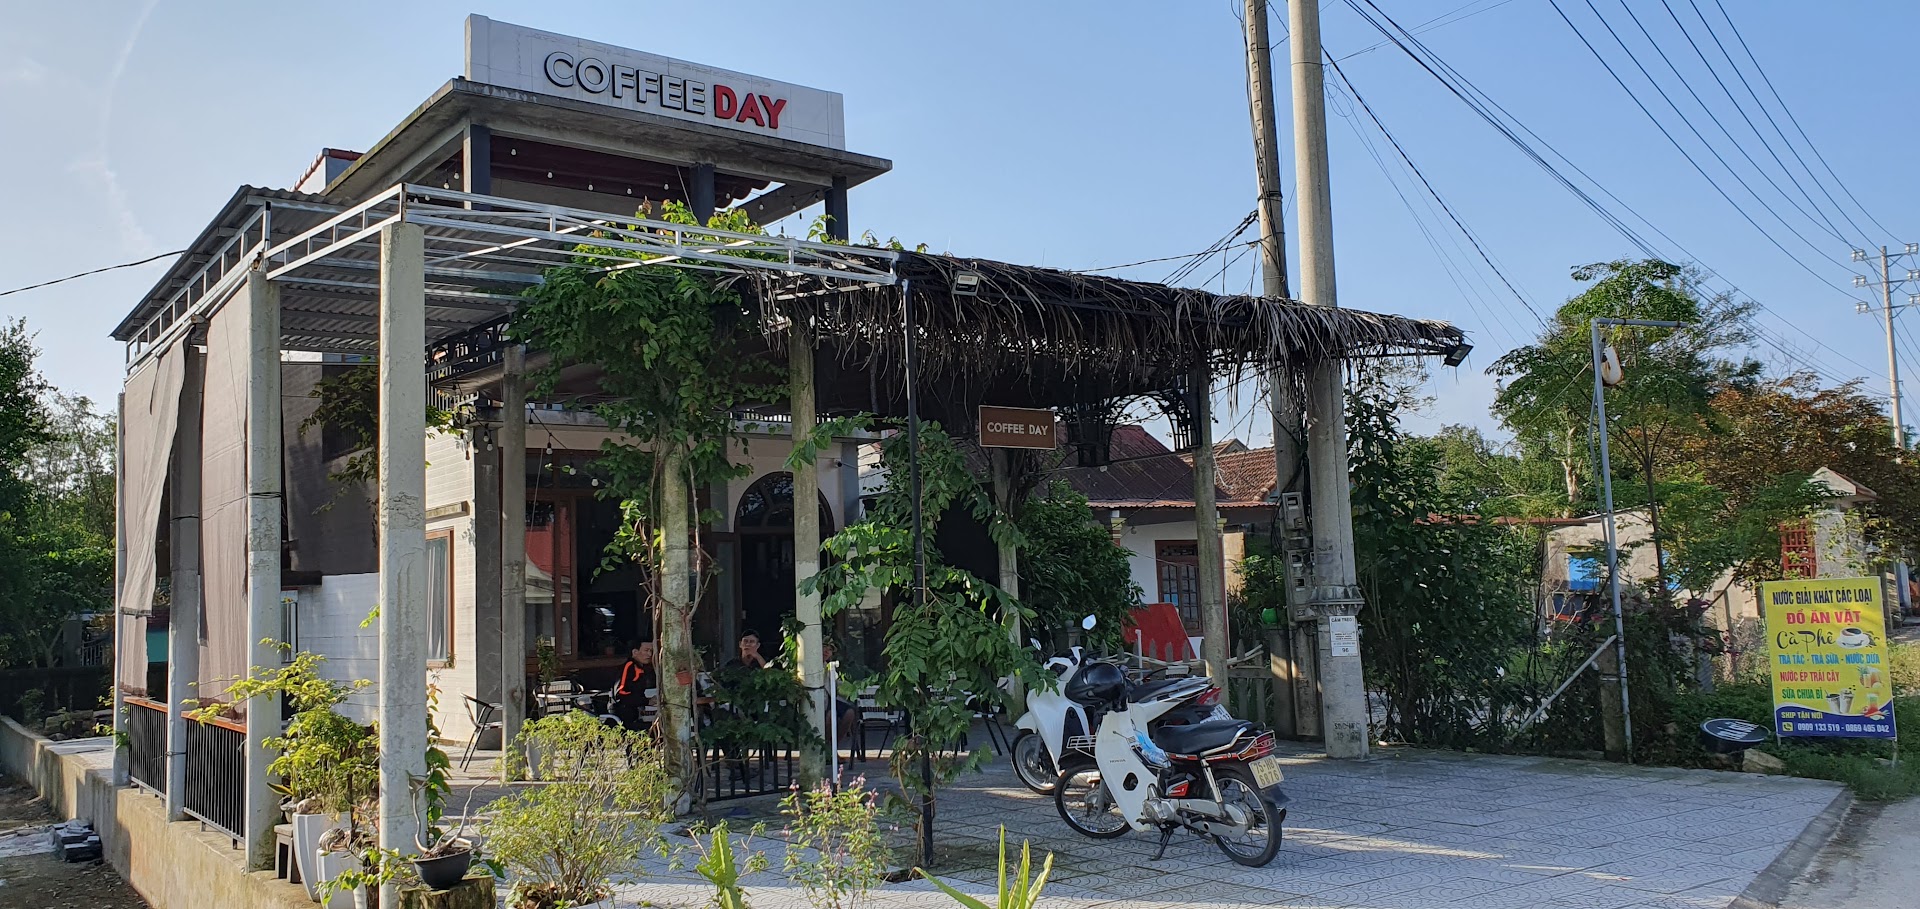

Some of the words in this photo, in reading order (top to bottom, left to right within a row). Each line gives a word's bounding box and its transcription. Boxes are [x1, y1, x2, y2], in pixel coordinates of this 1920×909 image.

[544, 51, 706, 115] COFFEE
[713, 84, 787, 130] DAY
[987, 422, 1025, 434] COFFEE
[1029, 424, 1048, 436] DAY
[1772, 588, 1794, 605] NƯỚC
[1796, 586, 1812, 604] GIẢI
[1813, 587, 1833, 603] KHÁT
[1836, 586, 1852, 603] CÁC
[1854, 588, 1873, 605] LOẠI
[1786, 608, 1806, 624] ĐỒ
[1811, 609, 1831, 624] ĂN
[1834, 608, 1862, 625] VẶT
[1776, 630, 1799, 650] Cà
[1797, 628, 1836, 653] Phê
[1779, 669, 1798, 682] NƯỚC
[1797, 688, 1815, 699] CHUA
[1781, 711, 1796, 719] SHIP
[1797, 723, 1813, 731] 0909
[1814, 723, 1827, 731] 133
[1827, 723, 1840, 732] 519
[1863, 724, 1876, 733] 495
[1259, 770, 1280, 785] 6876
